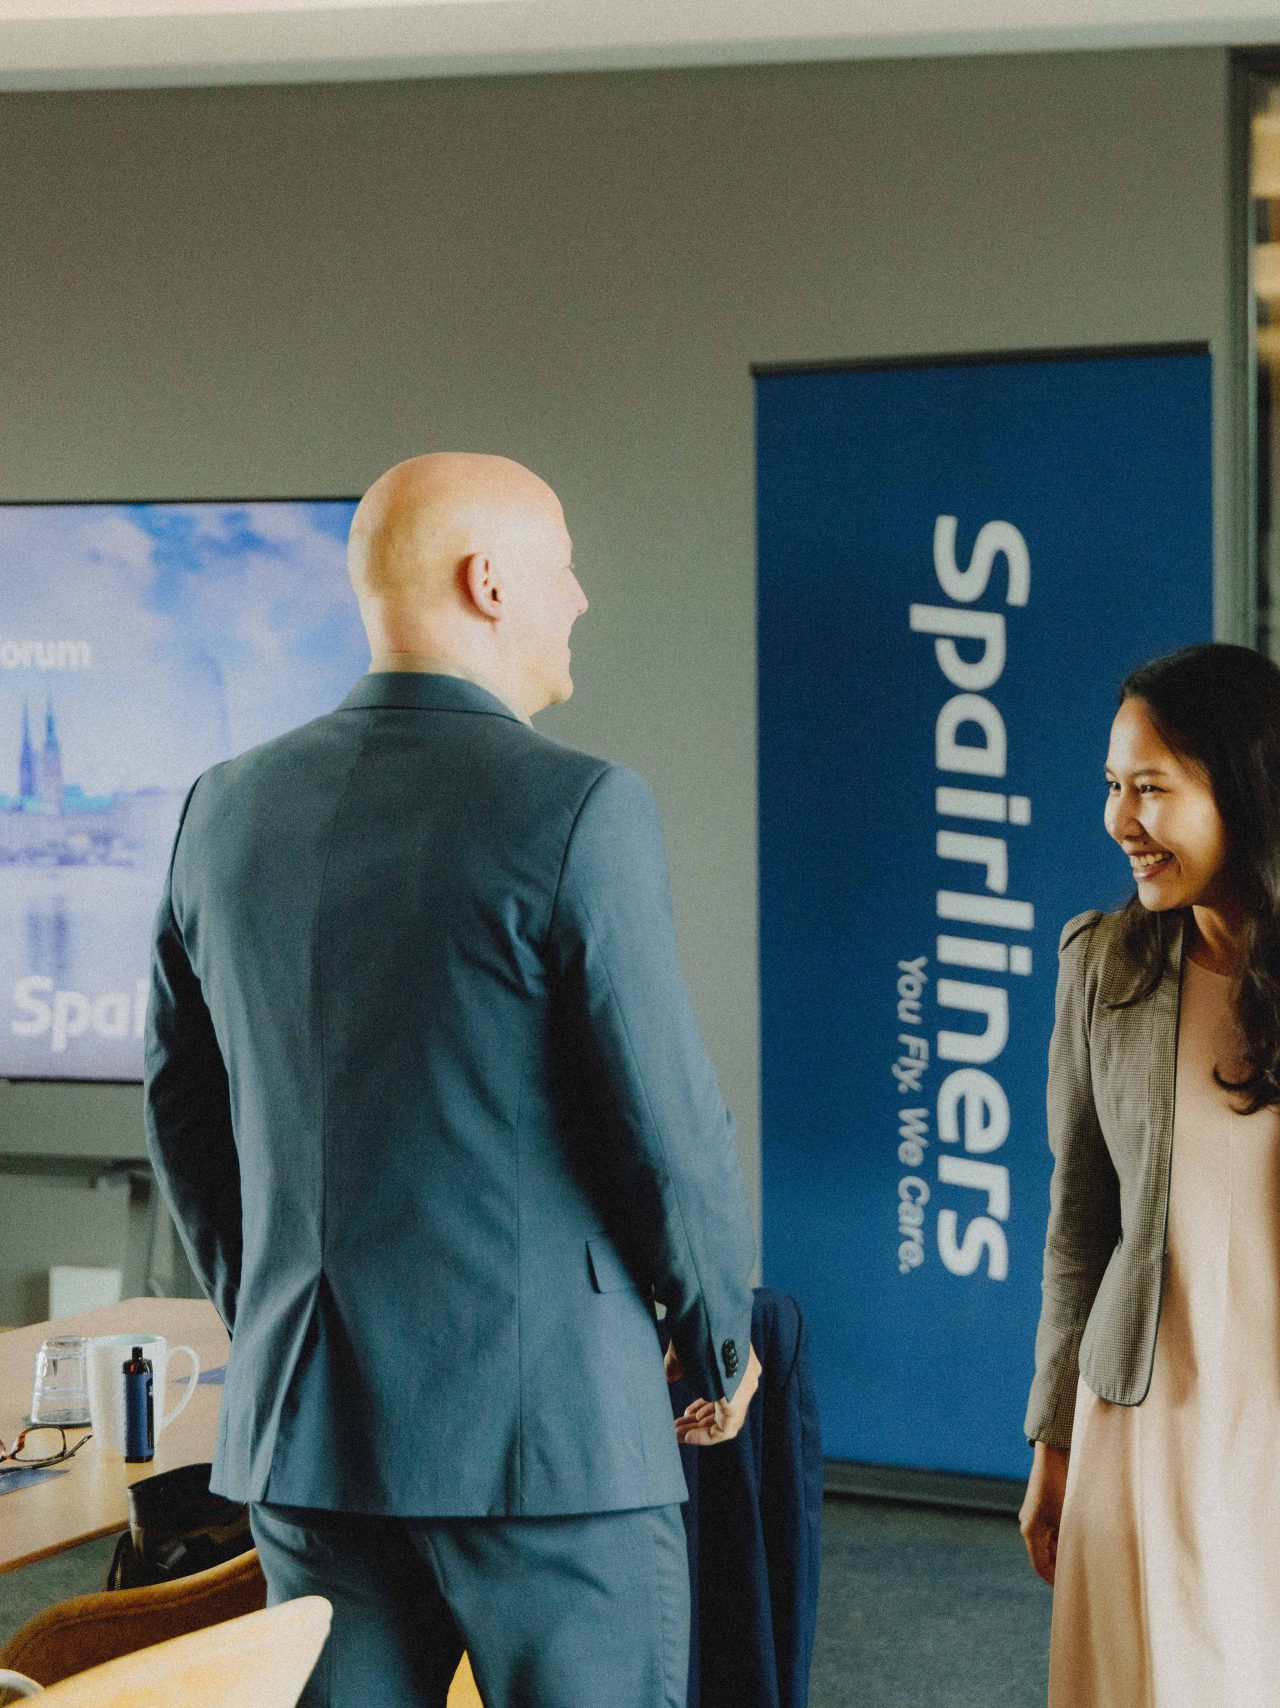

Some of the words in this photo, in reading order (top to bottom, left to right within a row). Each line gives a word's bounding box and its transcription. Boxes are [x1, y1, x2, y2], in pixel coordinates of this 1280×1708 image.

[909, 514, 1034, 1281] Spairliners
[897, 956, 928, 1024] You
[892, 1034, 930, 1092] Fly.
[898, 1107, 929, 1167] We
[897, 1175, 931, 1274] Care.
